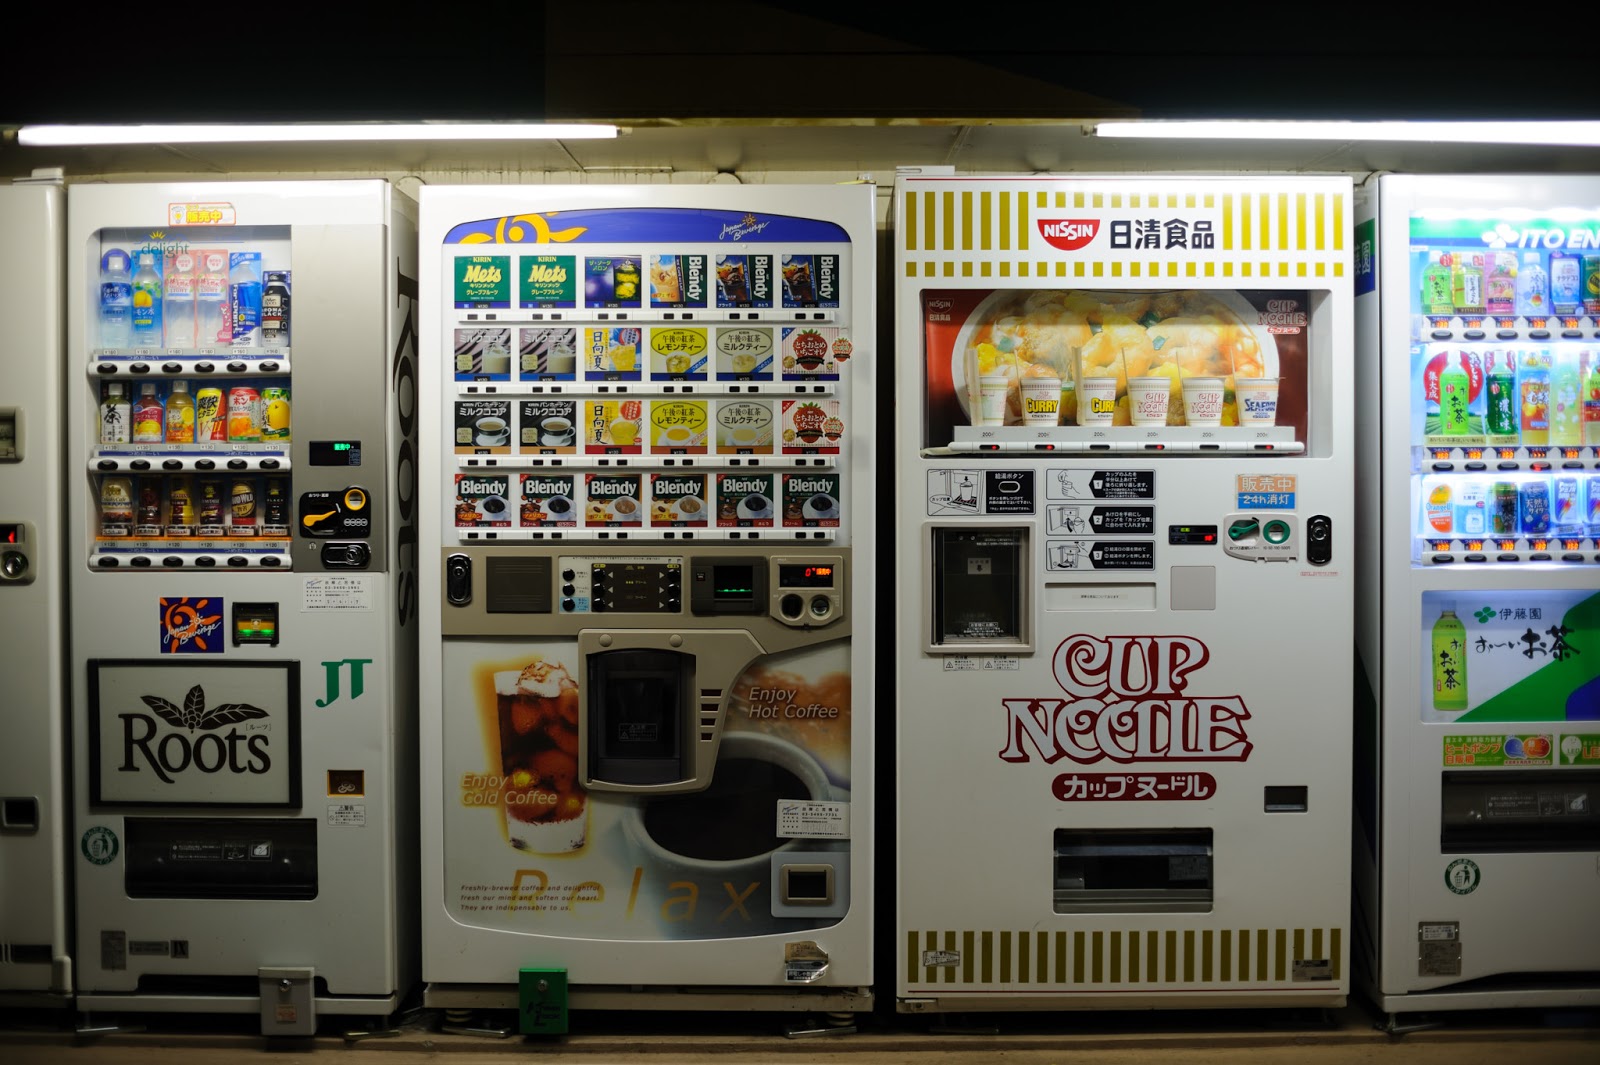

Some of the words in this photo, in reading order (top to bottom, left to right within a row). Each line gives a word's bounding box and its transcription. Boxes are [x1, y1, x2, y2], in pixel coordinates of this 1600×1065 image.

[1043, 221, 1094, 241] NISSIN
[1109, 218, 1215, 250] 日清食品
[1518, 229, 1565, 249] ITO
[141, 242, 190, 258] delight
[463, 265, 502, 283] Mets
[528, 265, 567, 283] Mets
[687, 256, 702, 301] Blendy
[754, 256, 768, 299] Blendy
[820, 256, 834, 299] Blendy
[928, 300, 952, 310] NISSIN
[1267, 300, 1298, 313] CUP
[928, 313, 951, 321] 日清食品
[662, 334, 696, 343] 午後の紅茶
[727, 334, 761, 343] 午後の紅茶
[794, 341, 827, 349] とちおとめ
[592, 330, 608, 371] 日向夏
[657, 343, 702, 351] レモンティー
[723, 343, 767, 351] ミルクティー
[1428, 371, 1439, 399] 集大成
[198, 395, 218, 411] 爽快
[233, 397, 249, 406] ポン
[1025, 397, 1059, 413] CURRY
[103, 403, 122, 423] 茶
[197, 409, 217, 419] ビタミン
[459, 407, 507, 416] ミルクココア
[524, 407, 572, 416] ミルクココア
[662, 408, 695, 416] 午後の紅茶
[727, 408, 761, 416] 午後の紅茶
[1451, 395, 1465, 424] お茶
[1499, 398, 1512, 431] 濃い味
[592, 405, 608, 445] 日向夏
[657, 416, 702, 424] レモンティー
[723, 416, 767, 424] ミルクティー
[795, 414, 825, 422] とちおとめ
[994, 472, 1024, 480] 給湯ボタン
[1242, 476, 1292, 491] 販売中
[461, 480, 507, 495] Blendy
[526, 480, 572, 495] Blendy
[591, 480, 637, 495] Blendy
[656, 480, 702, 495] Blendy
[722, 479, 768, 494] Blendy
[788, 479, 833, 494] Blendy
[1243, 494, 1290, 505] 24h消灯
[805, 568, 811, 576] 0
[1499, 607, 1542, 620] 伊藤園
[164, 621, 191, 644] Japan
[180, 622, 222, 645] Beverage
[1052, 633, 1210, 700] CUP
[1439, 650, 1461, 690] お茶
[315, 658, 373, 708] JT
[749, 687, 797, 703] Enjoy
[749, 704, 779, 719] Hot
[784, 704, 838, 719] Coffee
[118, 713, 272, 785] Roots
[1445, 743, 1502, 755] ヒートポンプ
[1445, 754, 1475, 765] 自販機
[462, 773, 509, 789] Enjoy
[1063, 775, 1209, 799] カップヌードル
[462, 791, 499, 806] Cold
[504, 790, 558, 806] Coffee
[508, 866, 761, 924] Relax
[563, 884, 600, 892] delightful
[460, 904, 478, 912] They
[495, 904, 547, 912] indispensable
